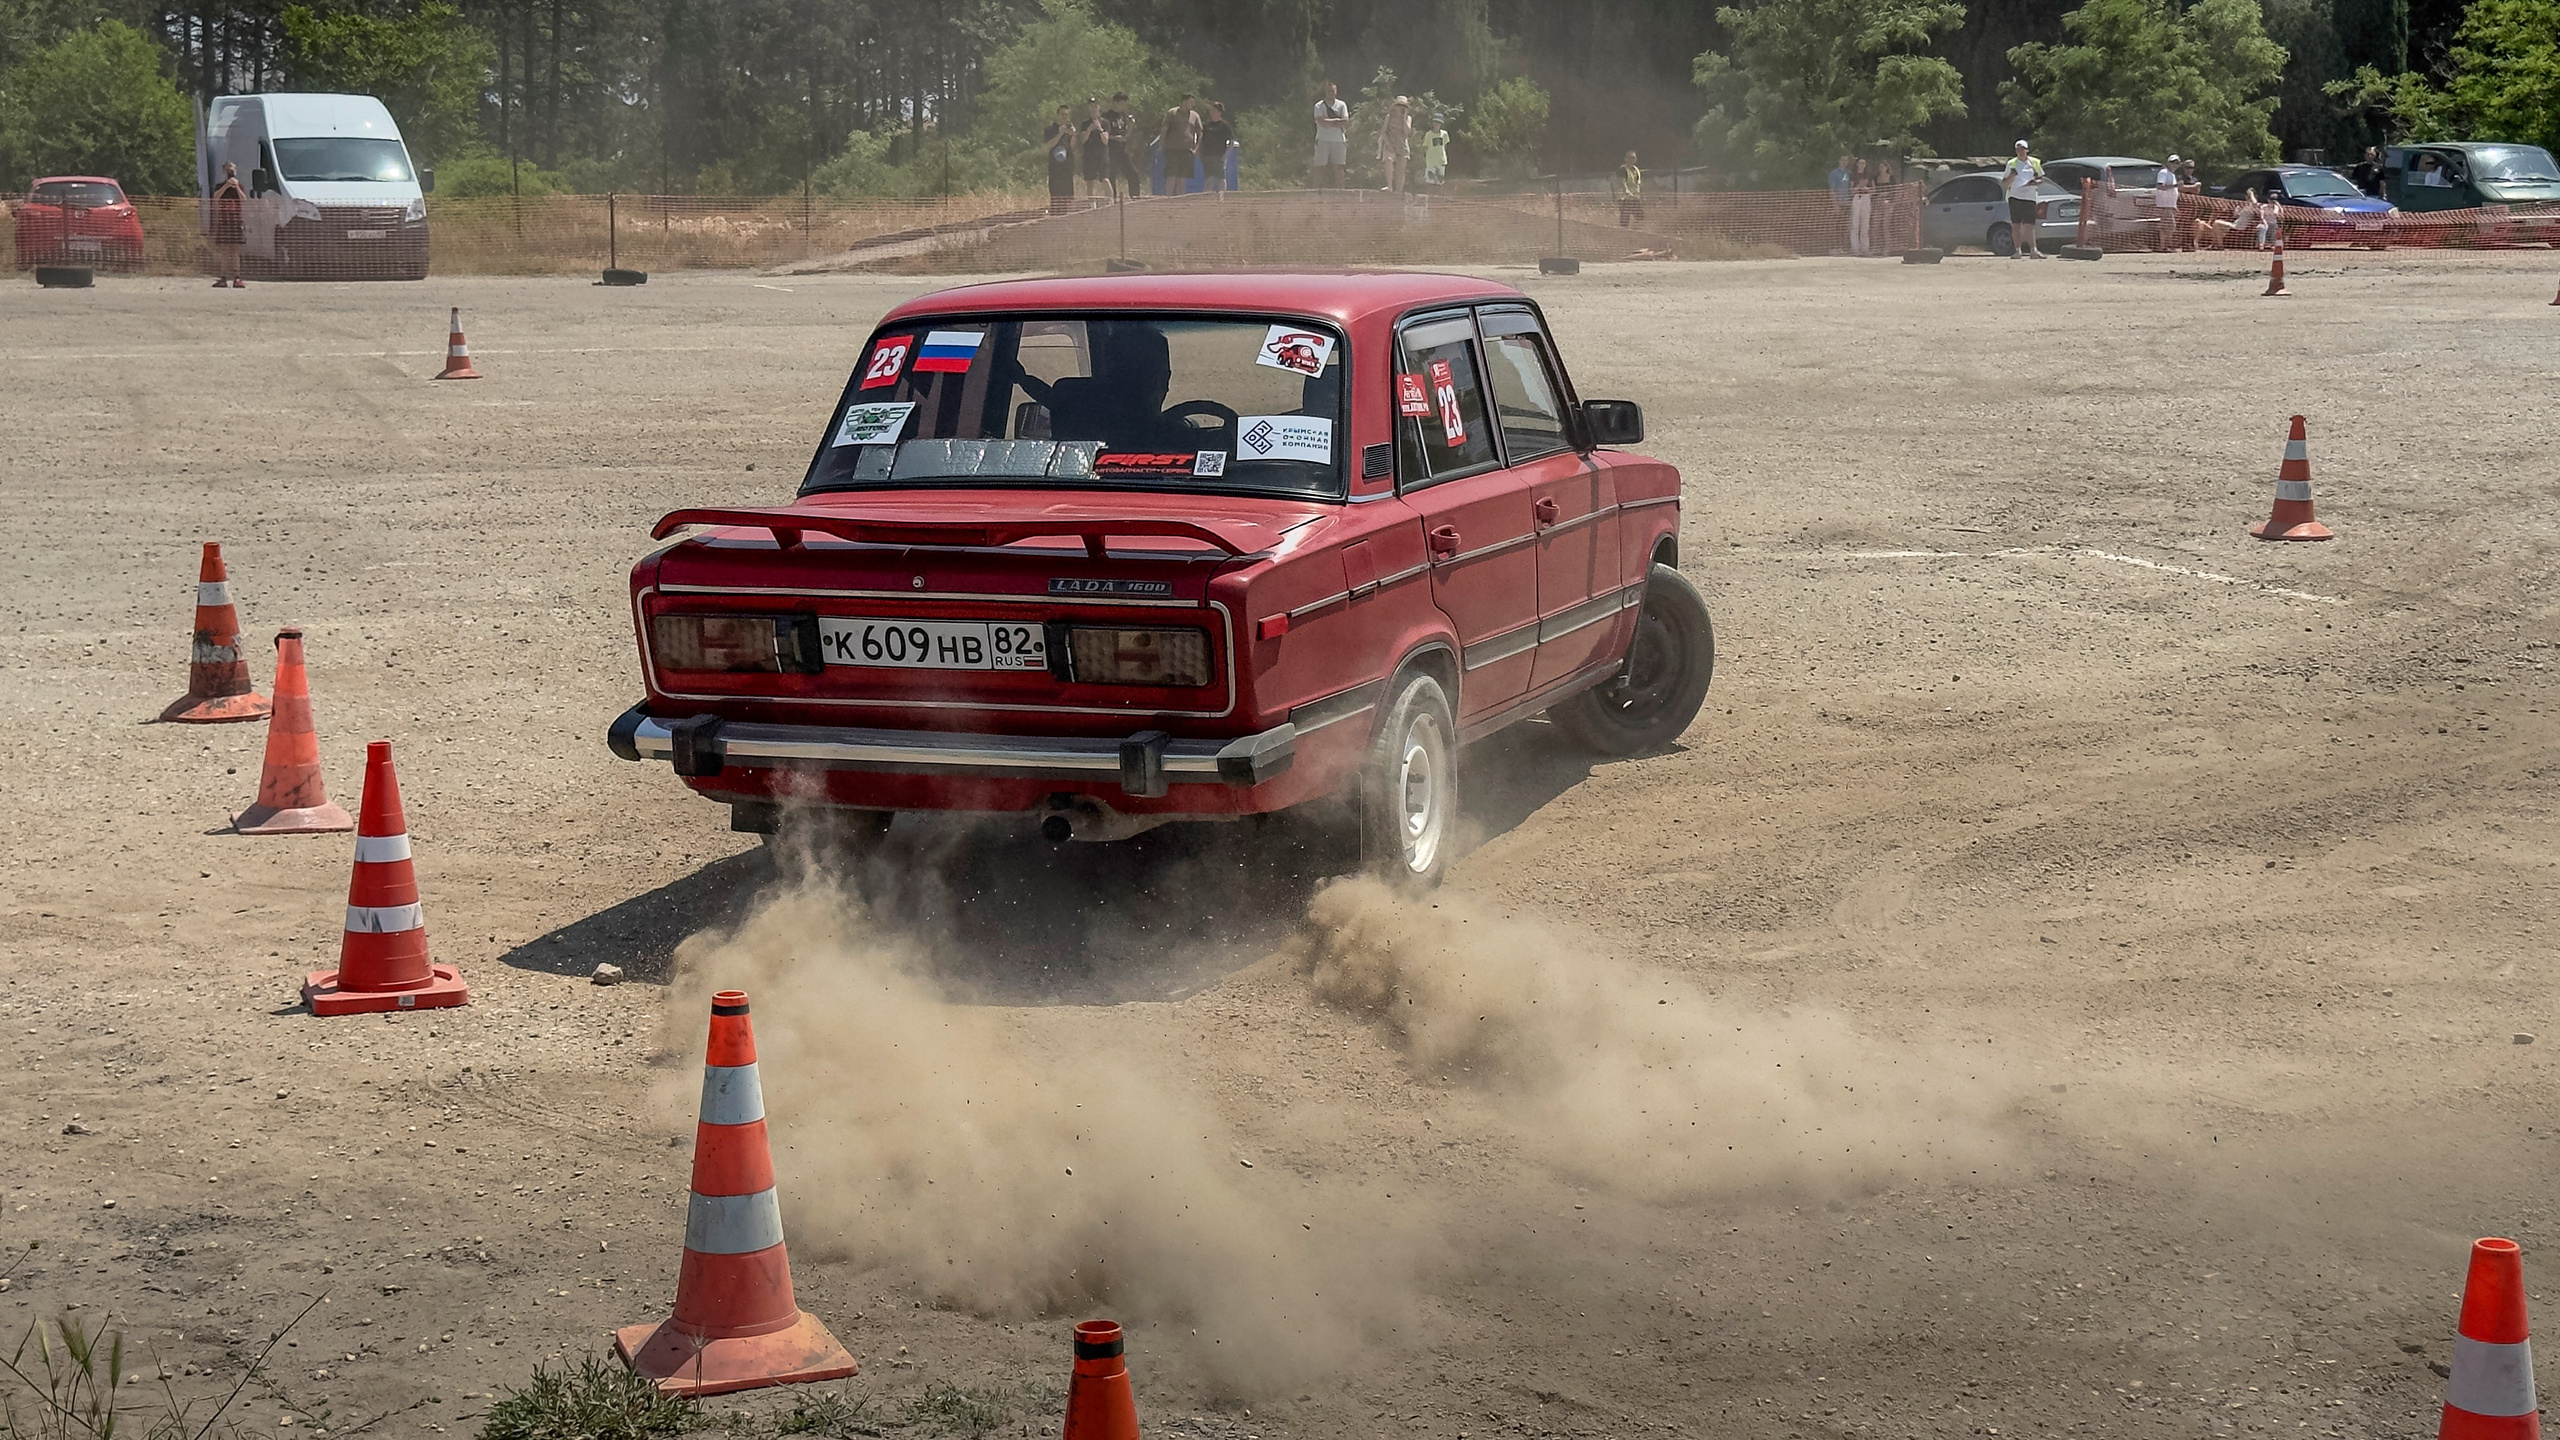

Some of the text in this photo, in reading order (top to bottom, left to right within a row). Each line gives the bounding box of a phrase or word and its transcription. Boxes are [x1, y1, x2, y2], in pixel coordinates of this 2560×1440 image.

[866, 345, 906, 381] 23
[1437, 384, 1463, 439] 23
[1095, 453, 1195, 466] FIRST
[1056, 580, 1166, 592] LADA 1600
[994, 627, 1033, 655] 82
[995, 655, 1023, 667] RUS
